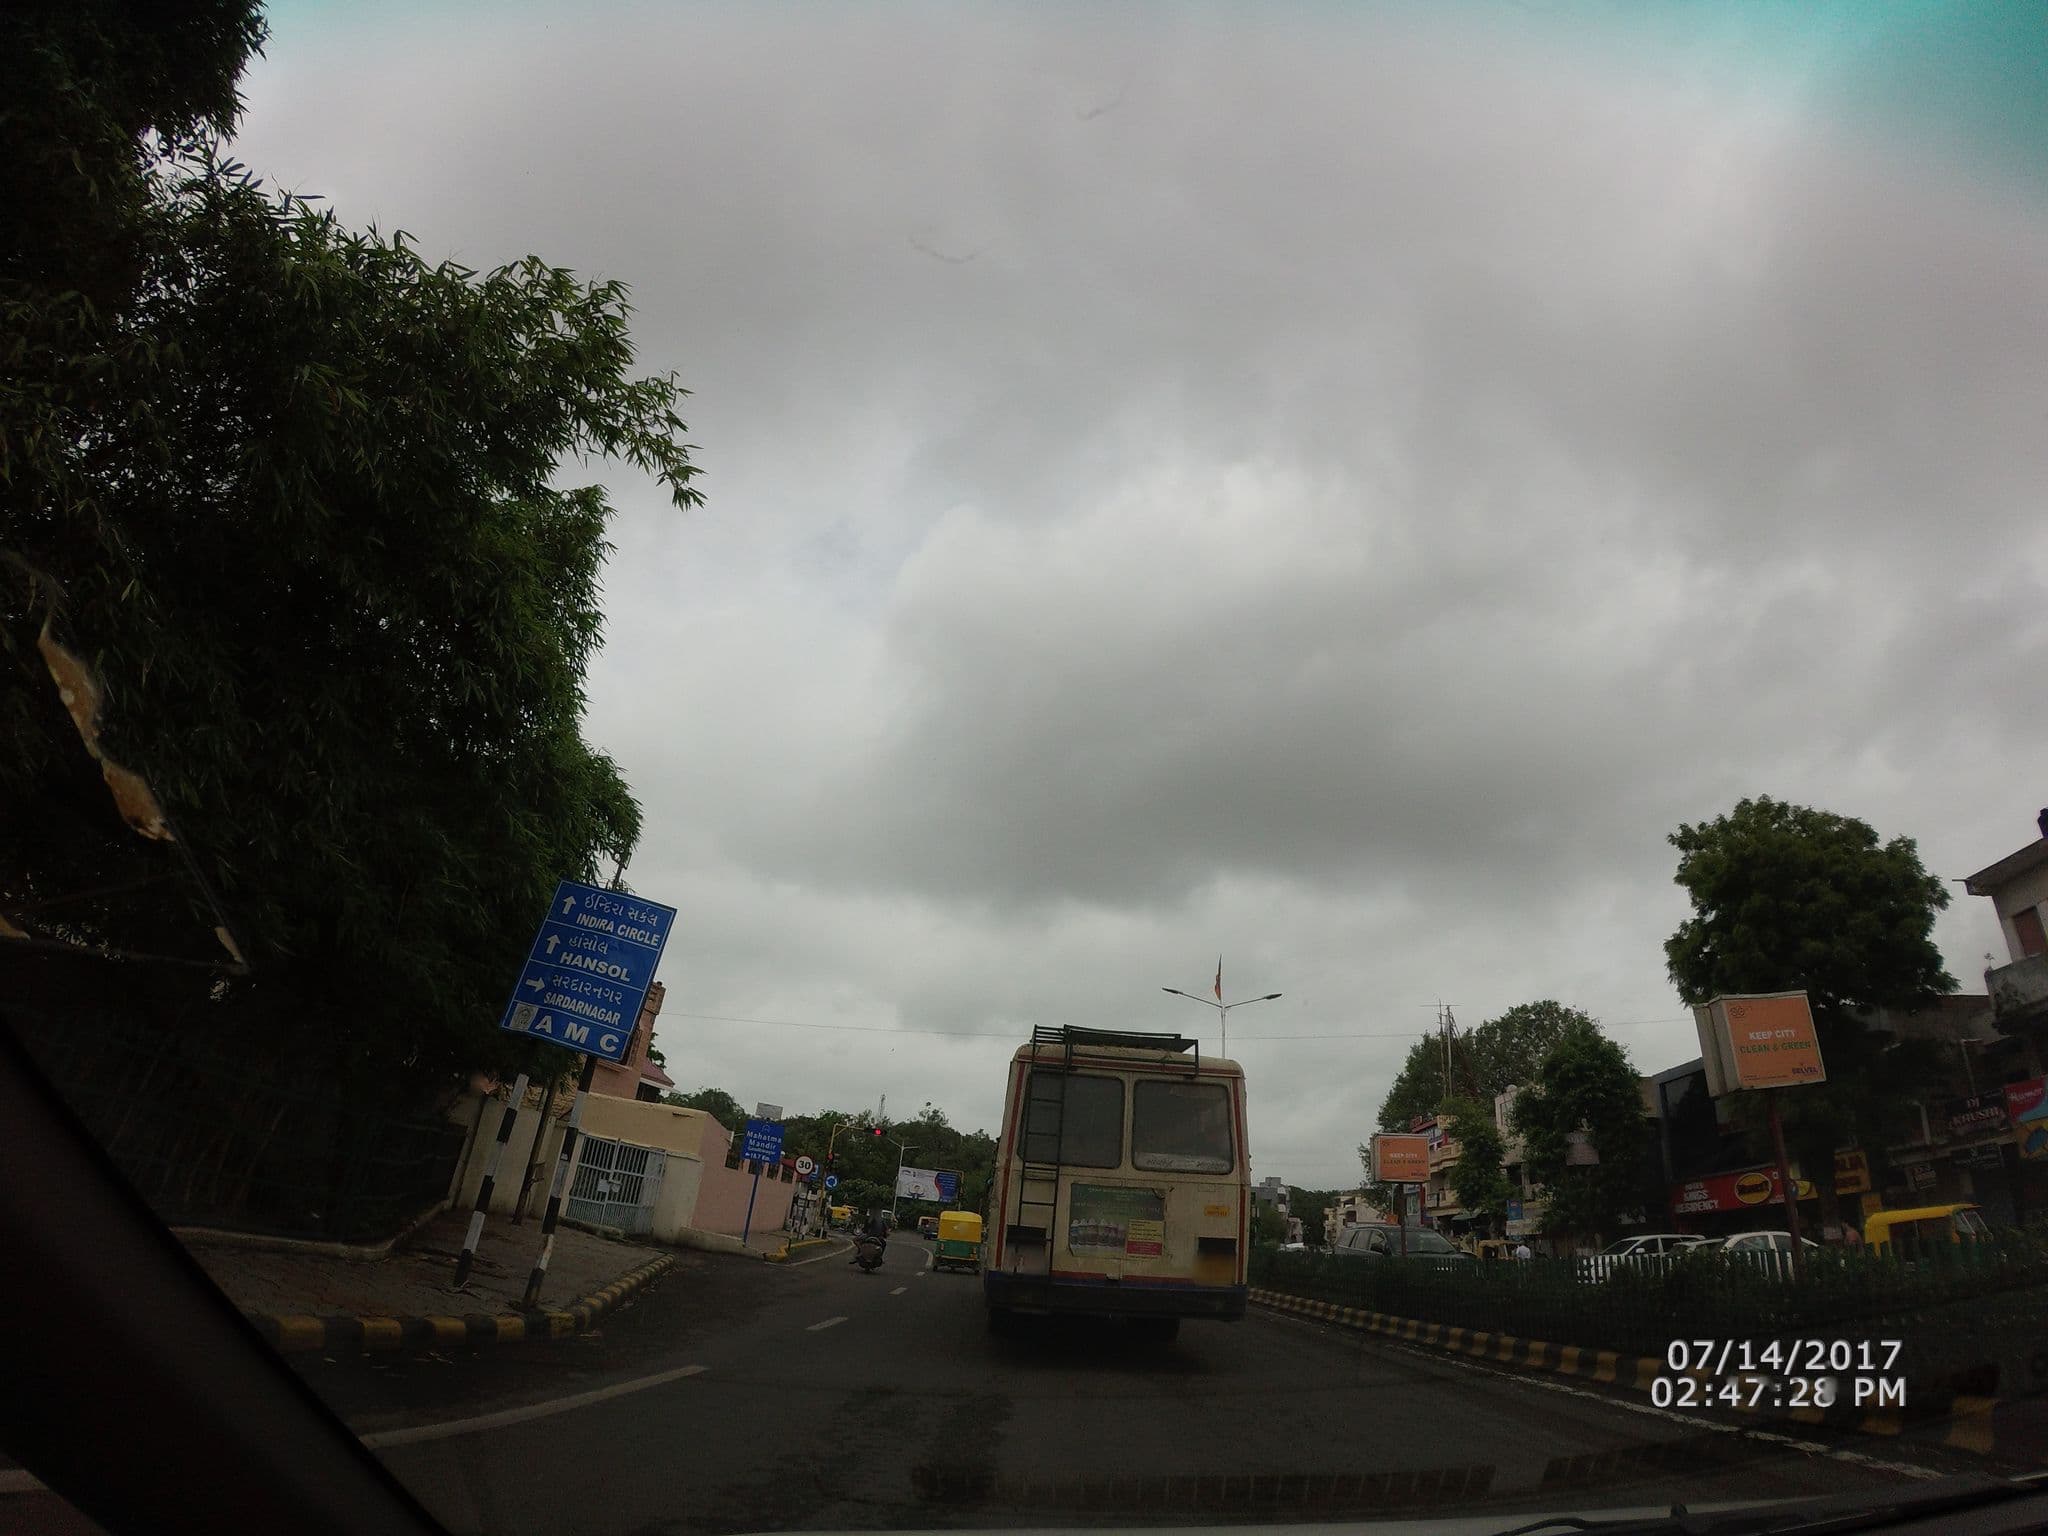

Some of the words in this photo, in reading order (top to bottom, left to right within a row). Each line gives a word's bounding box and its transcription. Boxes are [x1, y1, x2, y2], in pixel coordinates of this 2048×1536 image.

[576, 912, 614, 932] INDIRA
[617, 924, 660, 947] CIRCLE
[560, 951, 631, 982] HANSOL
[552, 974, 624, 1005] સરદારનગર
[544, 991, 621, 1026] SARDARNAGAR
[746, 1130, 782, 1144] Mahatma
[748, 1139, 777, 1150] Mandir
[798, 1160, 811, 1170] 30
